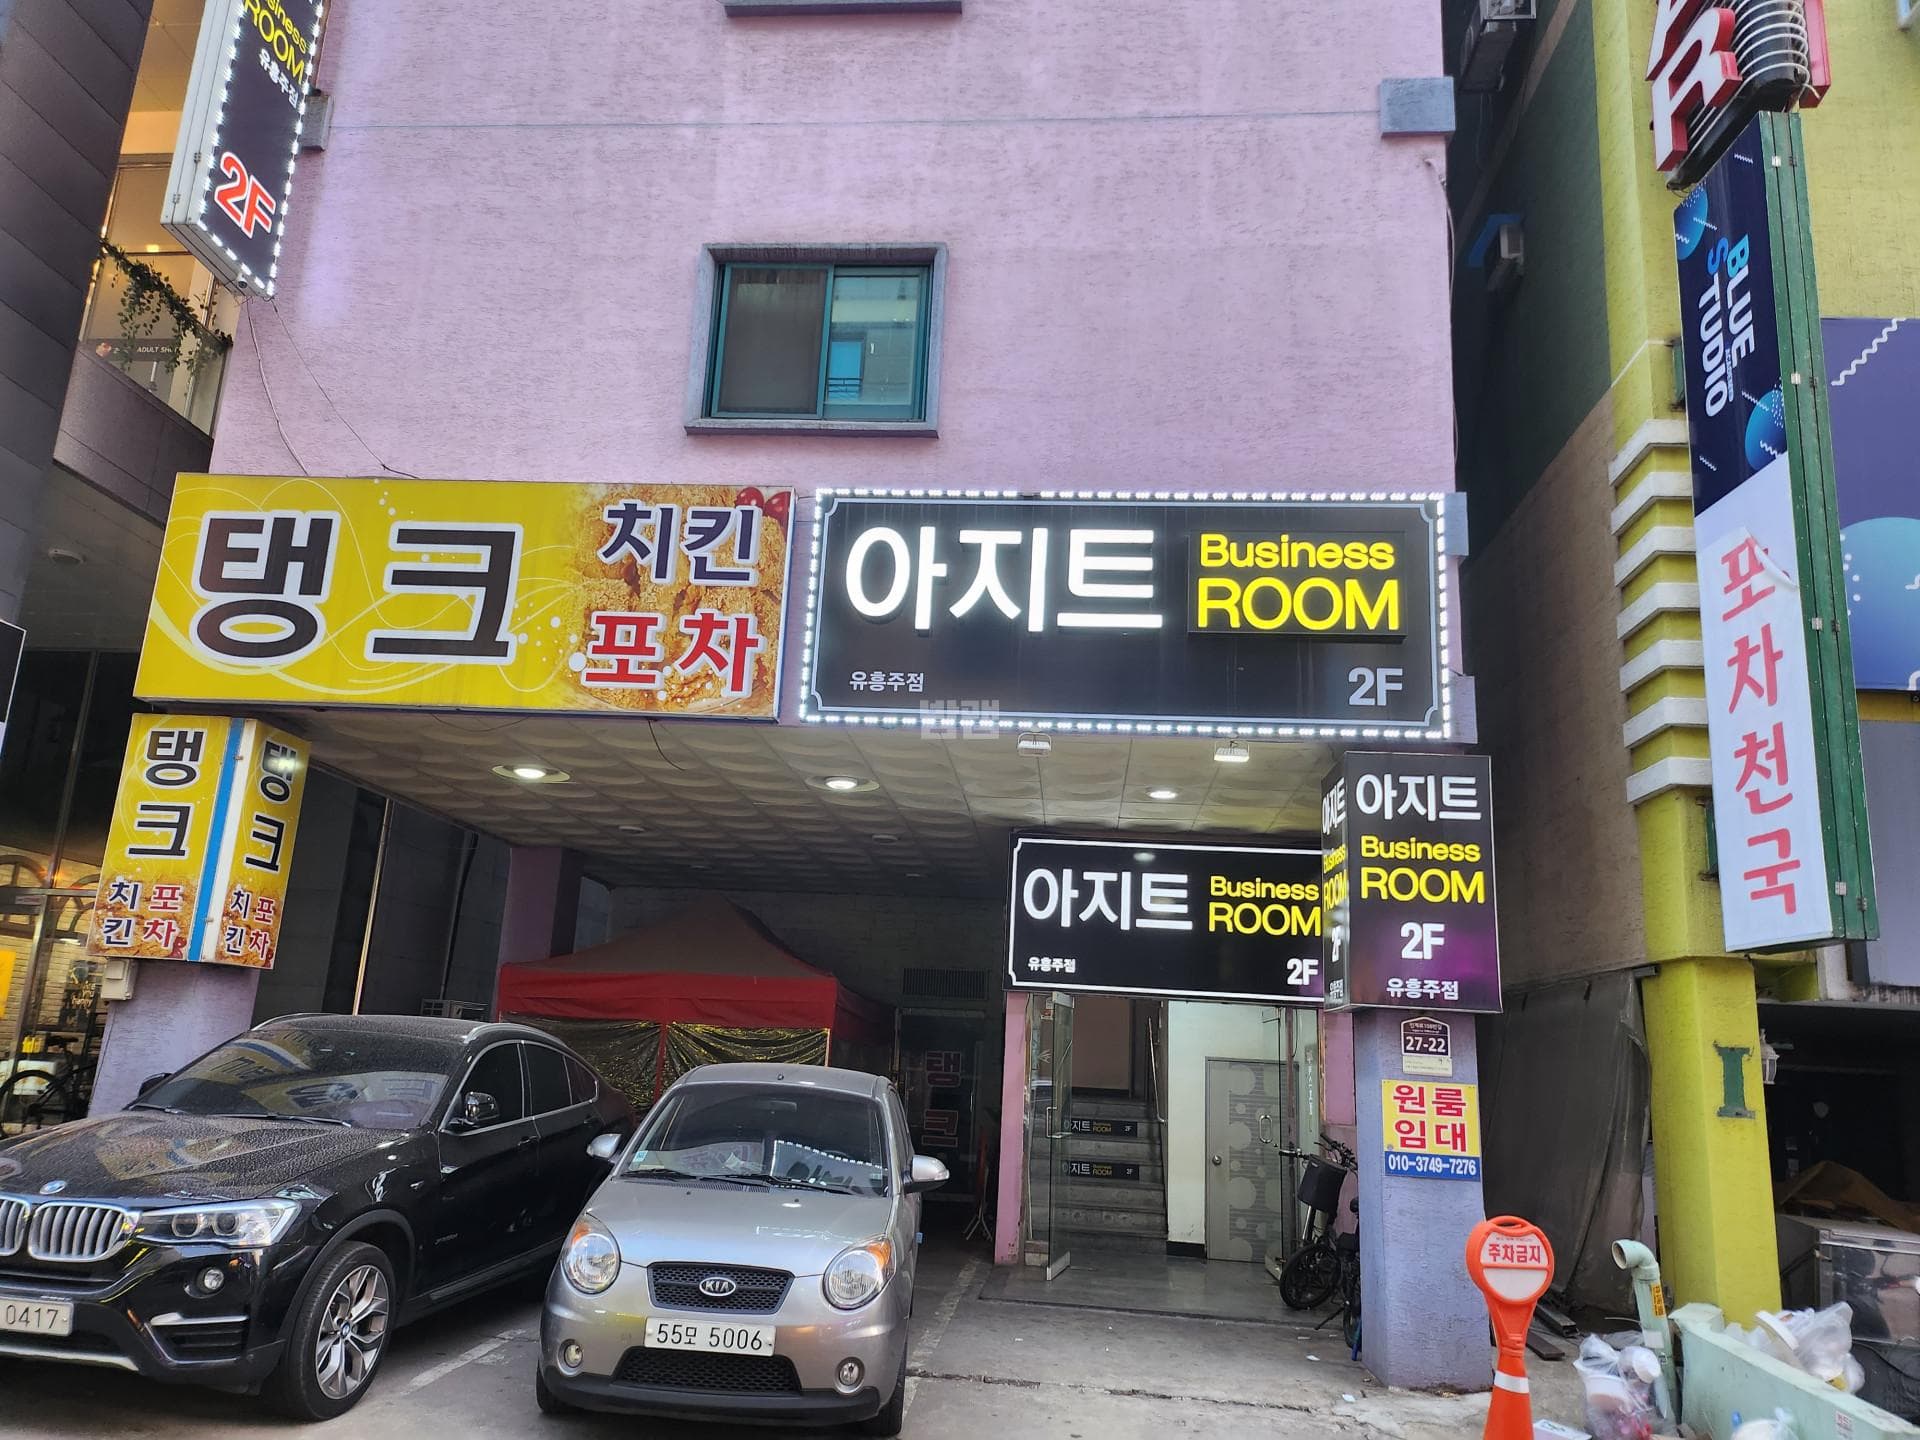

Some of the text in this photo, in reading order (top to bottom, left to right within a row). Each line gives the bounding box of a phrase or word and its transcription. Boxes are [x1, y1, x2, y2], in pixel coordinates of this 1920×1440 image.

[244, 0, 305, 84] ROOM
[214, 151, 276, 239] 2F
[1727, 233, 1755, 369] BLUE
[1699, 236, 1729, 417] STUDIO
[600, 501, 758, 585] 치킨
[1199, 532, 1395, 571] Business
[189, 510, 523, 665] 탱크
[845, 526, 1163, 633] 아지트
[1196, 577, 1400, 631] ROOM
[582, 612, 762, 697] 포차
[849, 670, 924, 694] 유흥주점
[1347, 666, 1403, 706] 2F
[1722, 536, 1801, 915] 포차천국
[127, 729, 204, 857] 탱크
[245, 740, 297, 872] 탱크
[1322, 777, 1346, 835] 아지트
[1355, 773, 1481, 822] 아지트
[1323, 843, 1346, 874] Business
[1360, 835, 1481, 863] Business
[1023, 868, 1193, 930] 아지트
[1210, 875, 1320, 901] Business
[1323, 869, 1347, 913] ROOM
[1360, 866, 1486, 905] ROOM
[103, 881, 139, 946] 치킨
[143, 884, 182, 949] 포차
[225, 889, 251, 956] 치킨
[250, 896, 276, 960] 포차
[1208, 901, 1322, 937] ROOM
[1400, 921, 1446, 960] 2F
[1028, 956, 1076, 974] 유흥주점
[1286, 957, 1319, 986] 2F
[1386, 977, 1459, 1001] 유흥주점
[1406, 1035, 1446, 1053] 27-22
[1393, 1084, 1466, 1117] 원룸
[1394, 1119, 1466, 1152] 임대
[1388, 1154, 1477, 1176] 010-3749-7276
[1488, 1243, 1541, 1264] 주차금지
[705, 1280, 730, 1292] KIA
[6, 1304, 59, 1329] 0417
[656, 1323, 762, 1351] 55모 5006
